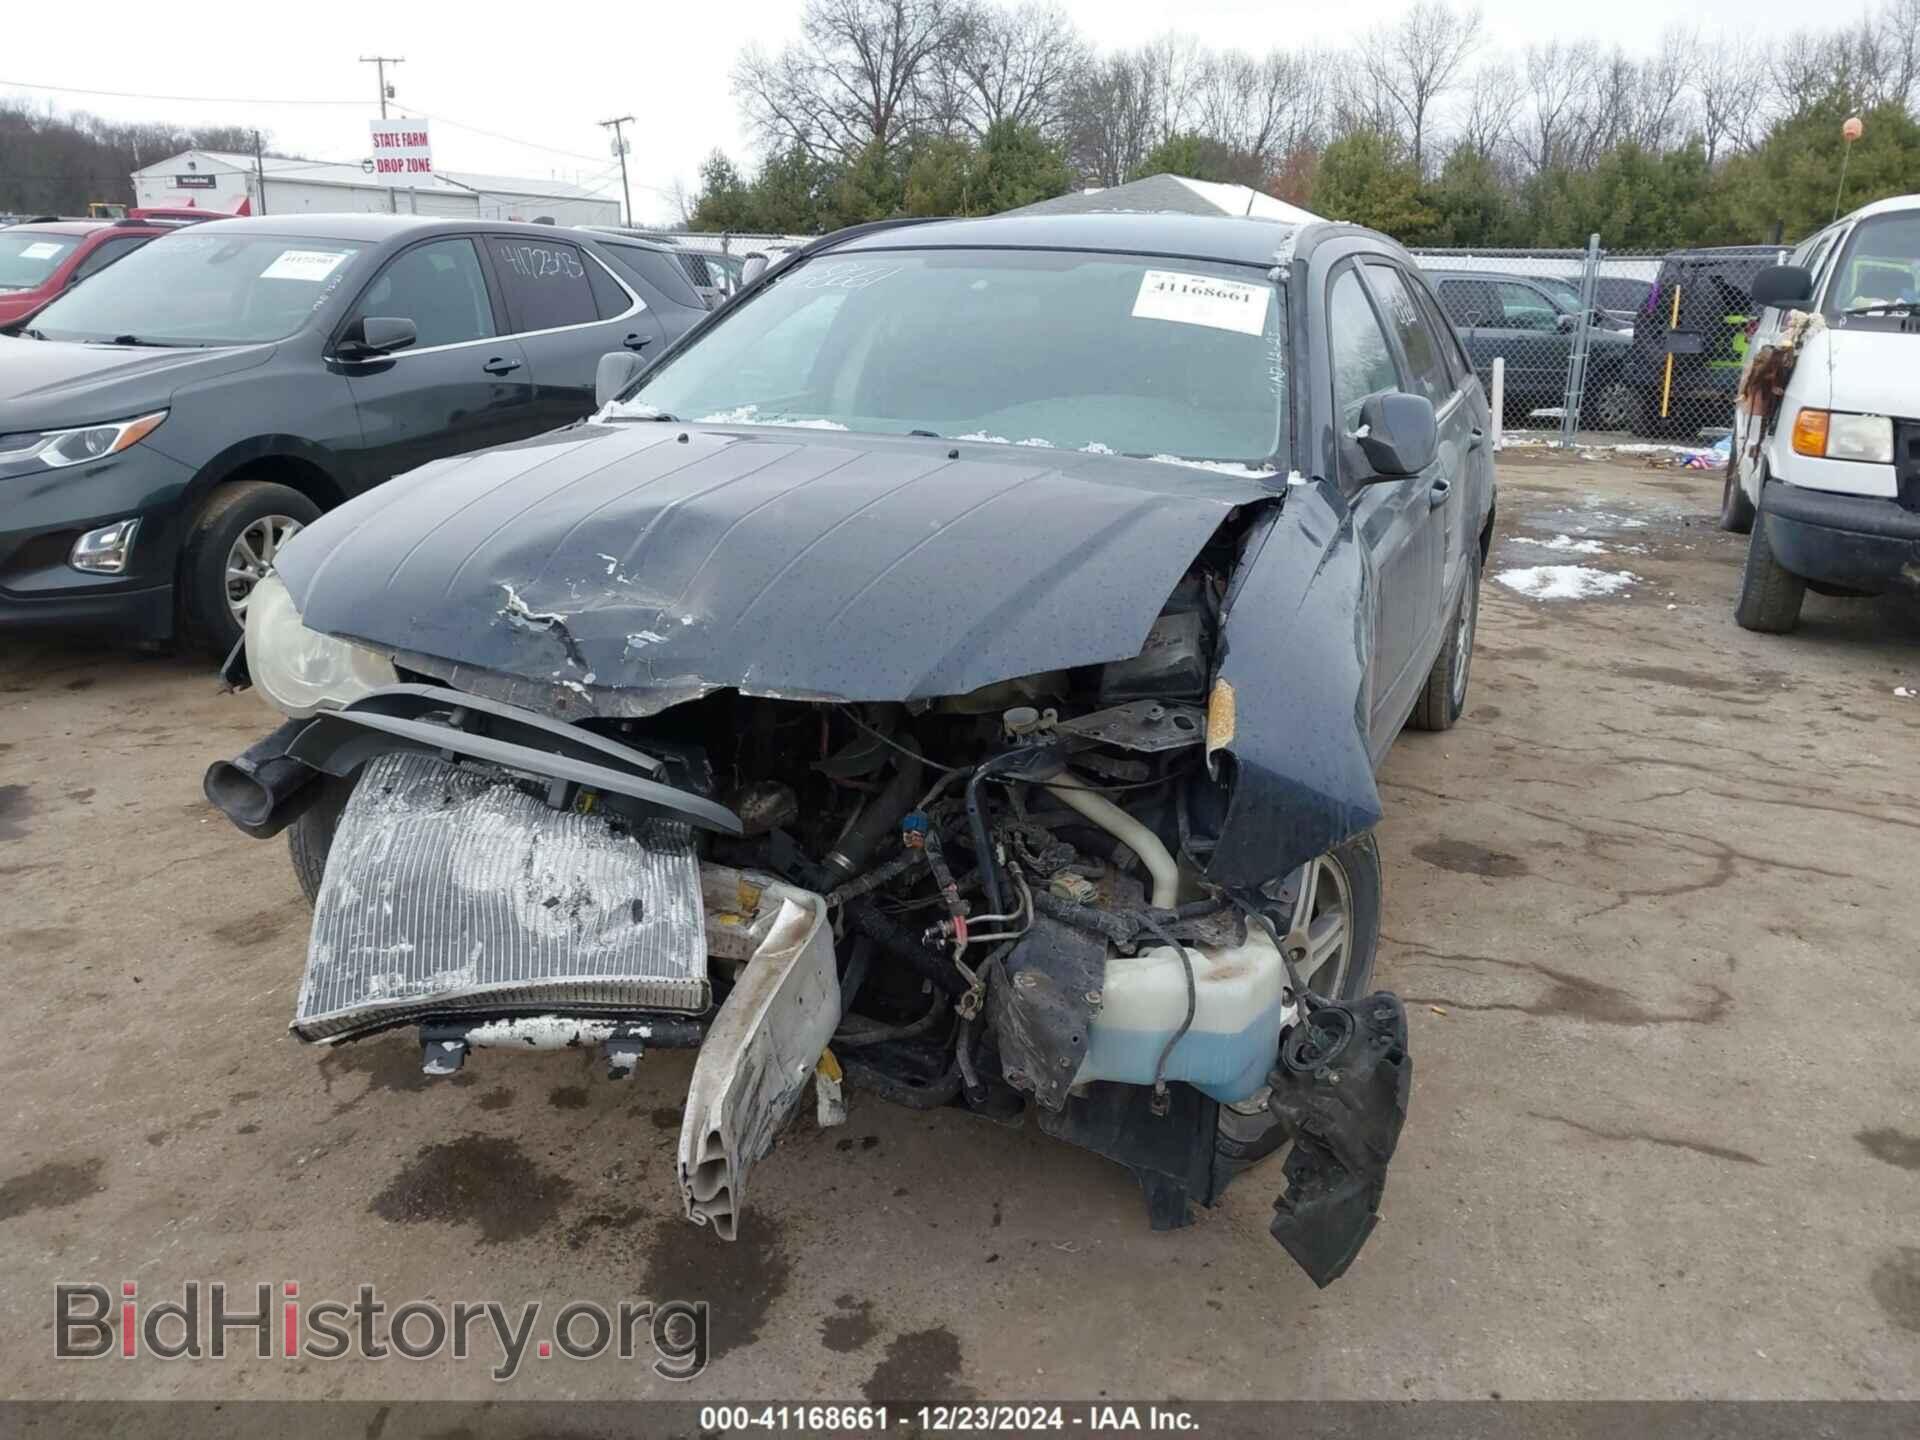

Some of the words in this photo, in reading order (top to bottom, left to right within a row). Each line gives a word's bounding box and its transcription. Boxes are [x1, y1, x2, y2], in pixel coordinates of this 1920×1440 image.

[372, 132, 401, 148] STATE
[402, 131, 428, 147] FARM
[376, 158, 404, 173] DROP
[406, 157, 432, 173] ZONE
[1153, 281, 1251, 304] 41168661
